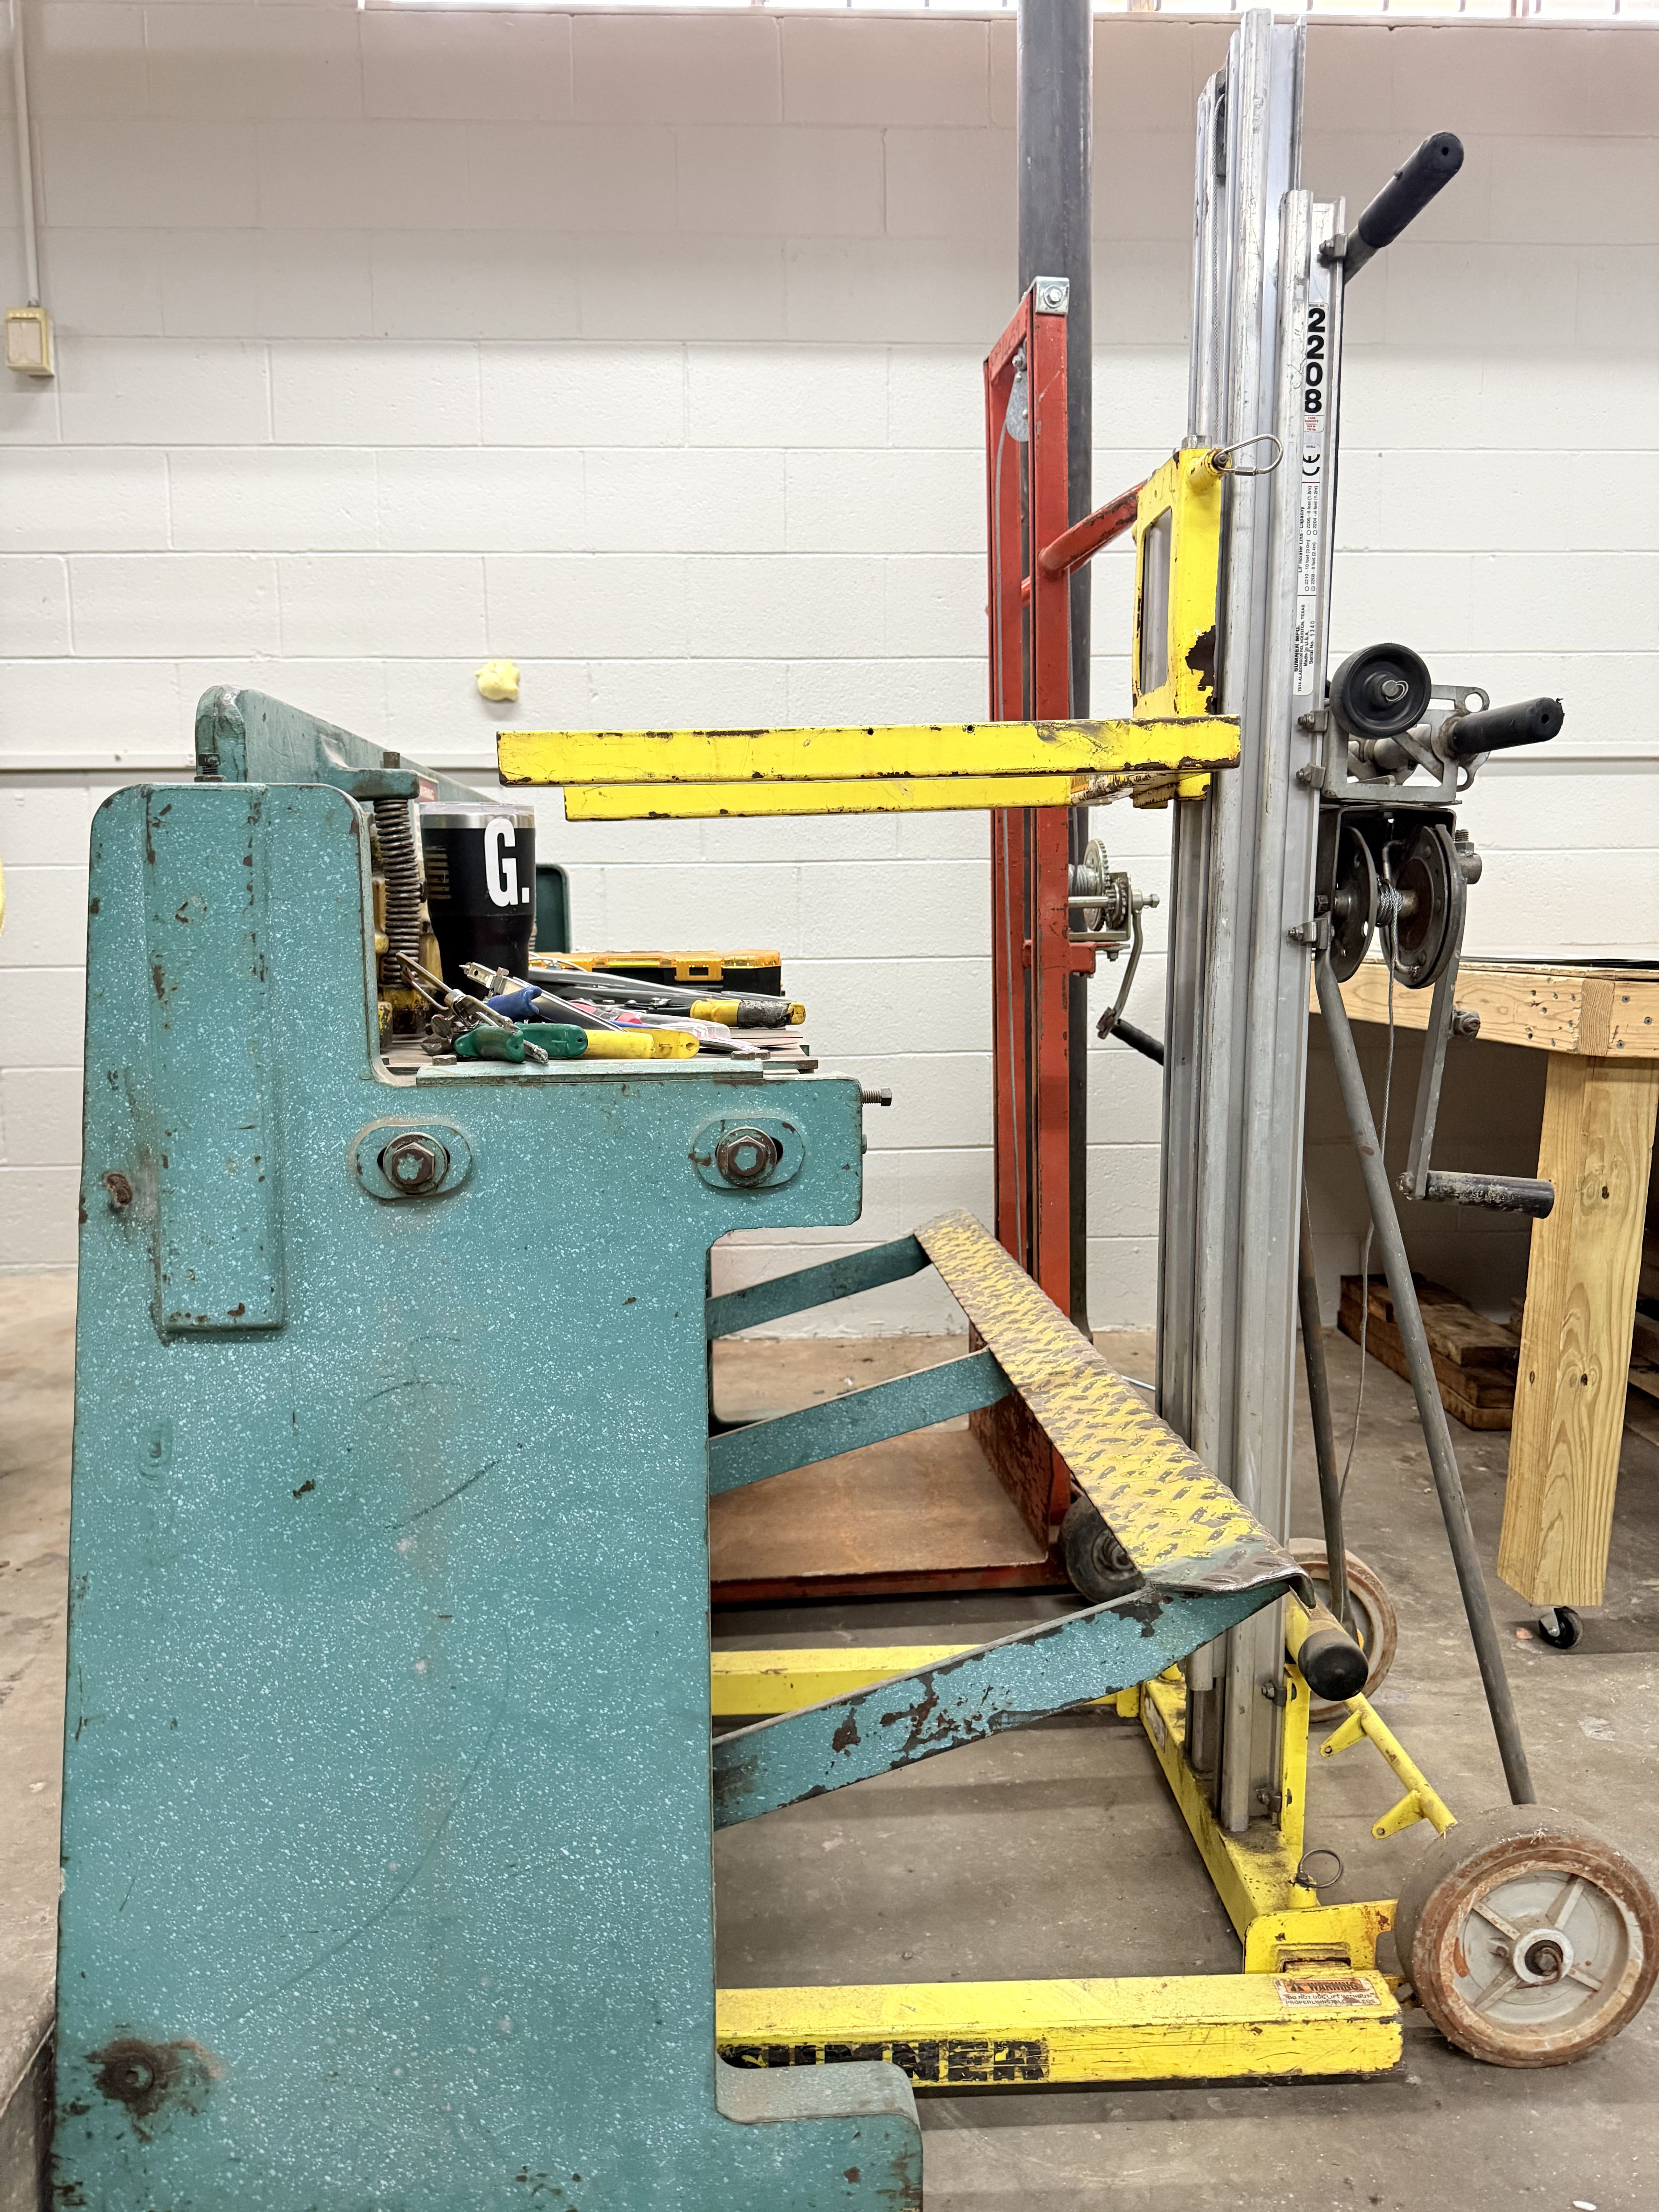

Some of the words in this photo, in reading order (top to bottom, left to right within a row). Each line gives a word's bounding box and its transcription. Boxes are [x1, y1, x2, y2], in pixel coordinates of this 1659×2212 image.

[1305, 308, 1325, 413] 2208
[484, 818, 530, 907] G.
[1308, 1981, 1358, 1991] WARNING
